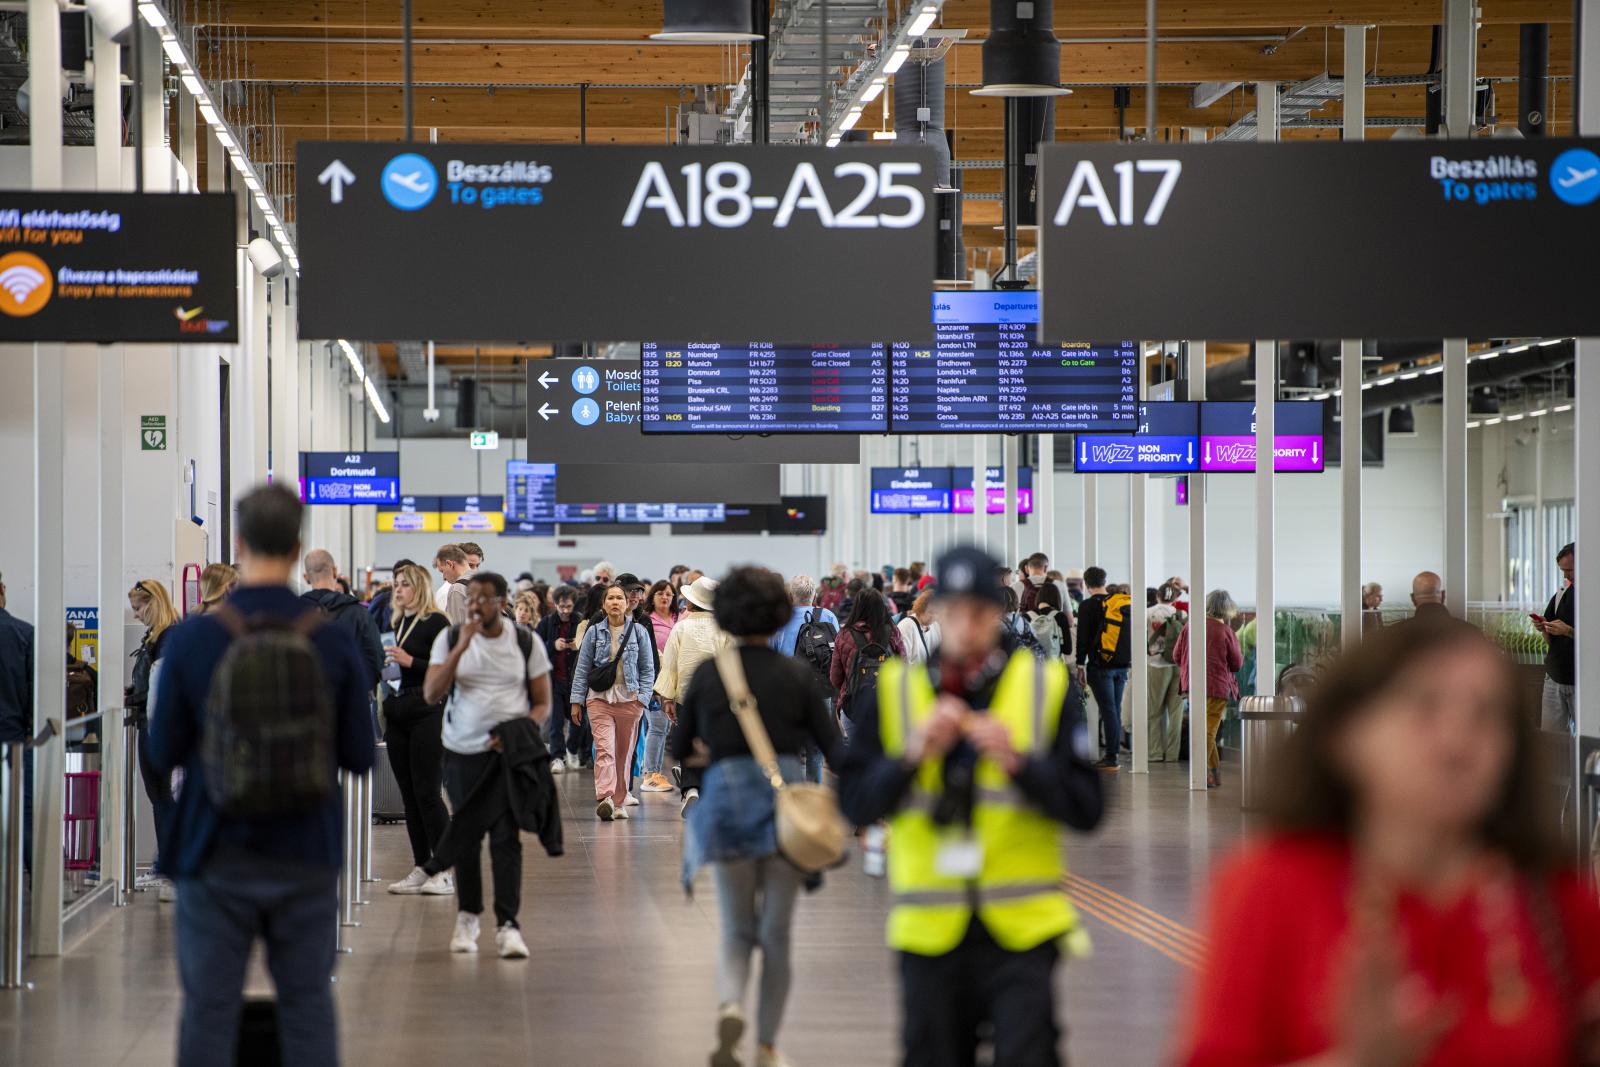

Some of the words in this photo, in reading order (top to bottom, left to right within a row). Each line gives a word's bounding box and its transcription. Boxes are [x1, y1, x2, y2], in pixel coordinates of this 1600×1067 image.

[447, 159, 552, 183] Beszállás
[1430, 155, 1538, 179] Beszállás
[448, 182, 480, 204] To
[481, 182, 543, 209] gates
[622, 161, 926, 228] A18-A25
[1054, 160, 1182, 226] A17
[1440, 178, 1470, 201] To
[1474, 181, 1537, 206] gates
[0, 208, 20, 228] ifi
[24, 228, 48, 244] for
[50, 229, 84, 246] you
[58, 284, 93, 298] Enjoy
[94, 284, 116, 298] the
[118, 285, 192, 298] connections
[994, 303, 1038, 311] Departures
[606, 412, 633, 424] Baby
[1138, 445, 1160, 453] NON
[1138, 454, 1182, 462] PRIORITY
[345, 454, 360, 463] A22
[330, 467, 376, 476] Dortmund
